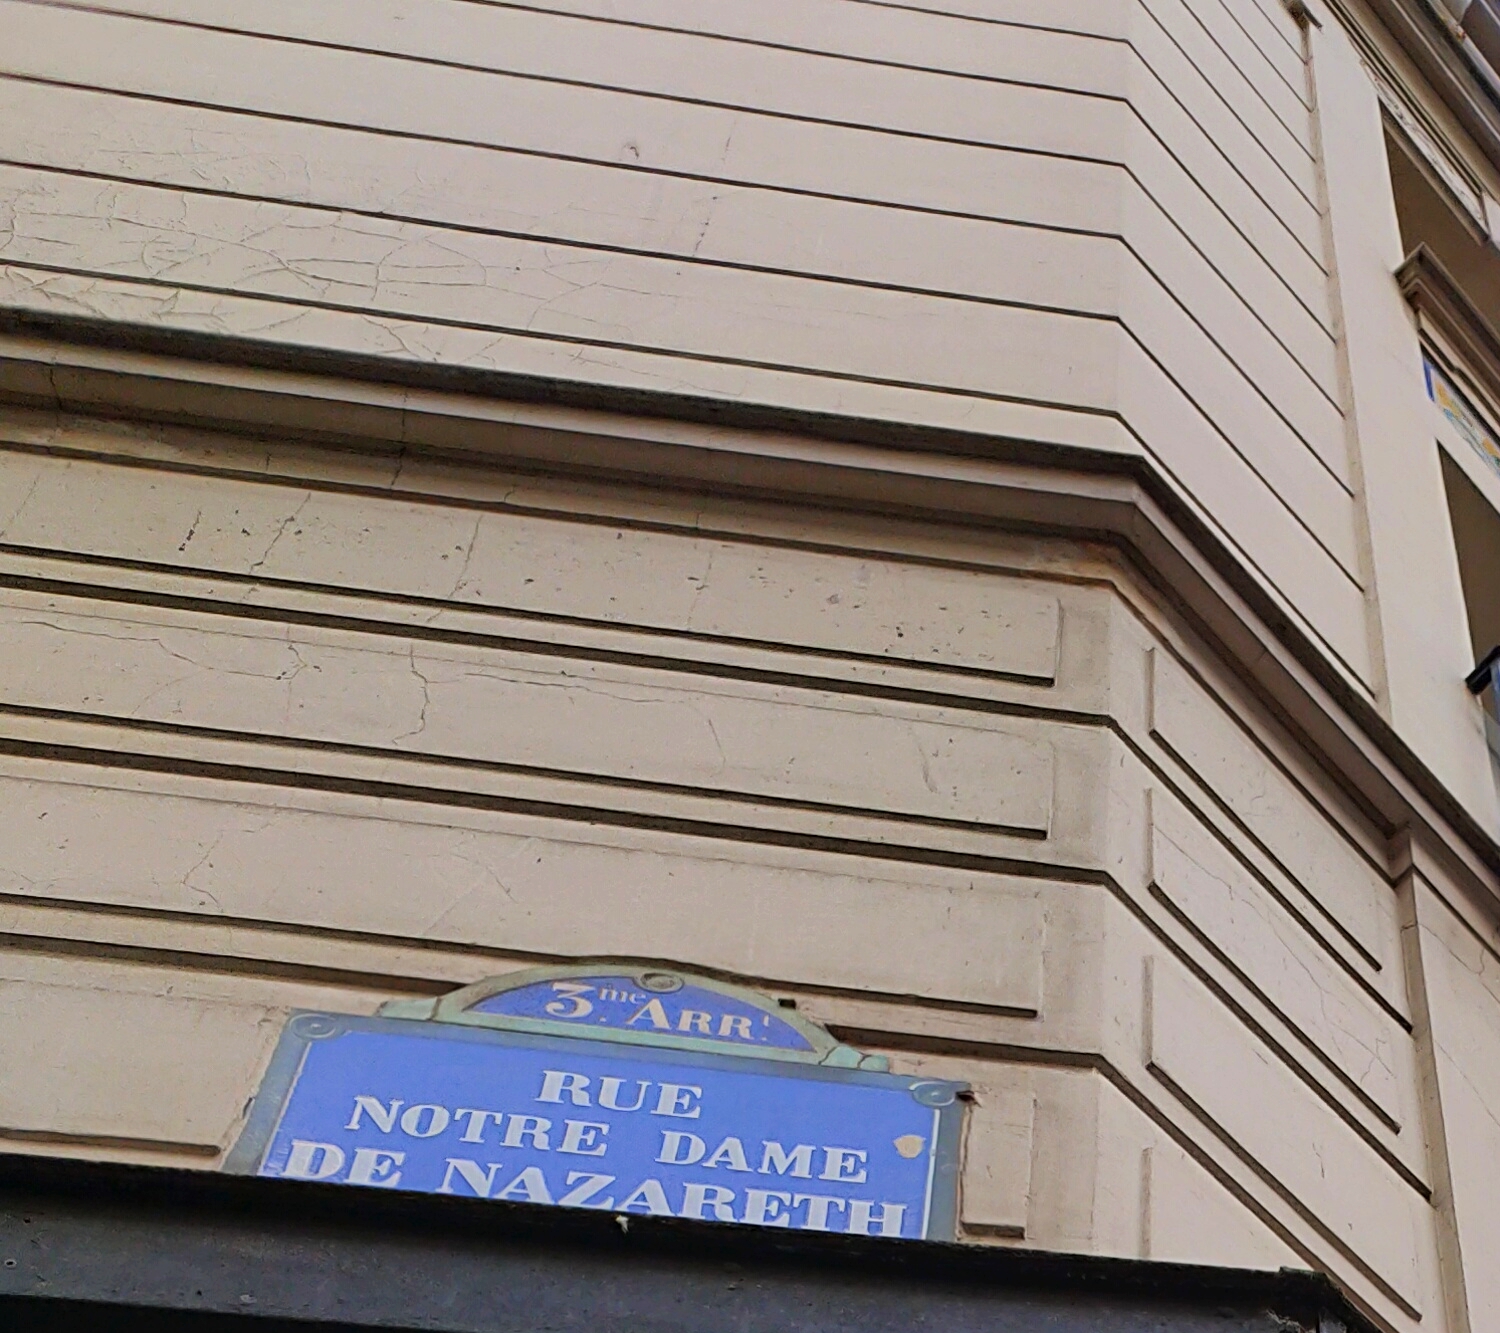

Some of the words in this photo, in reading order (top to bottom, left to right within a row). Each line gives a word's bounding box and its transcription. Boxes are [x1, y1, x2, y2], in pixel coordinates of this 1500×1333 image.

[344, 1094, 610, 1157] NOTRE
[654, 1129, 868, 1184] DAME
[534, 1069, 703, 1119] RUE
[280, 1138, 406, 1189] DE
[435, 1157, 908, 1238] NAZARETH
